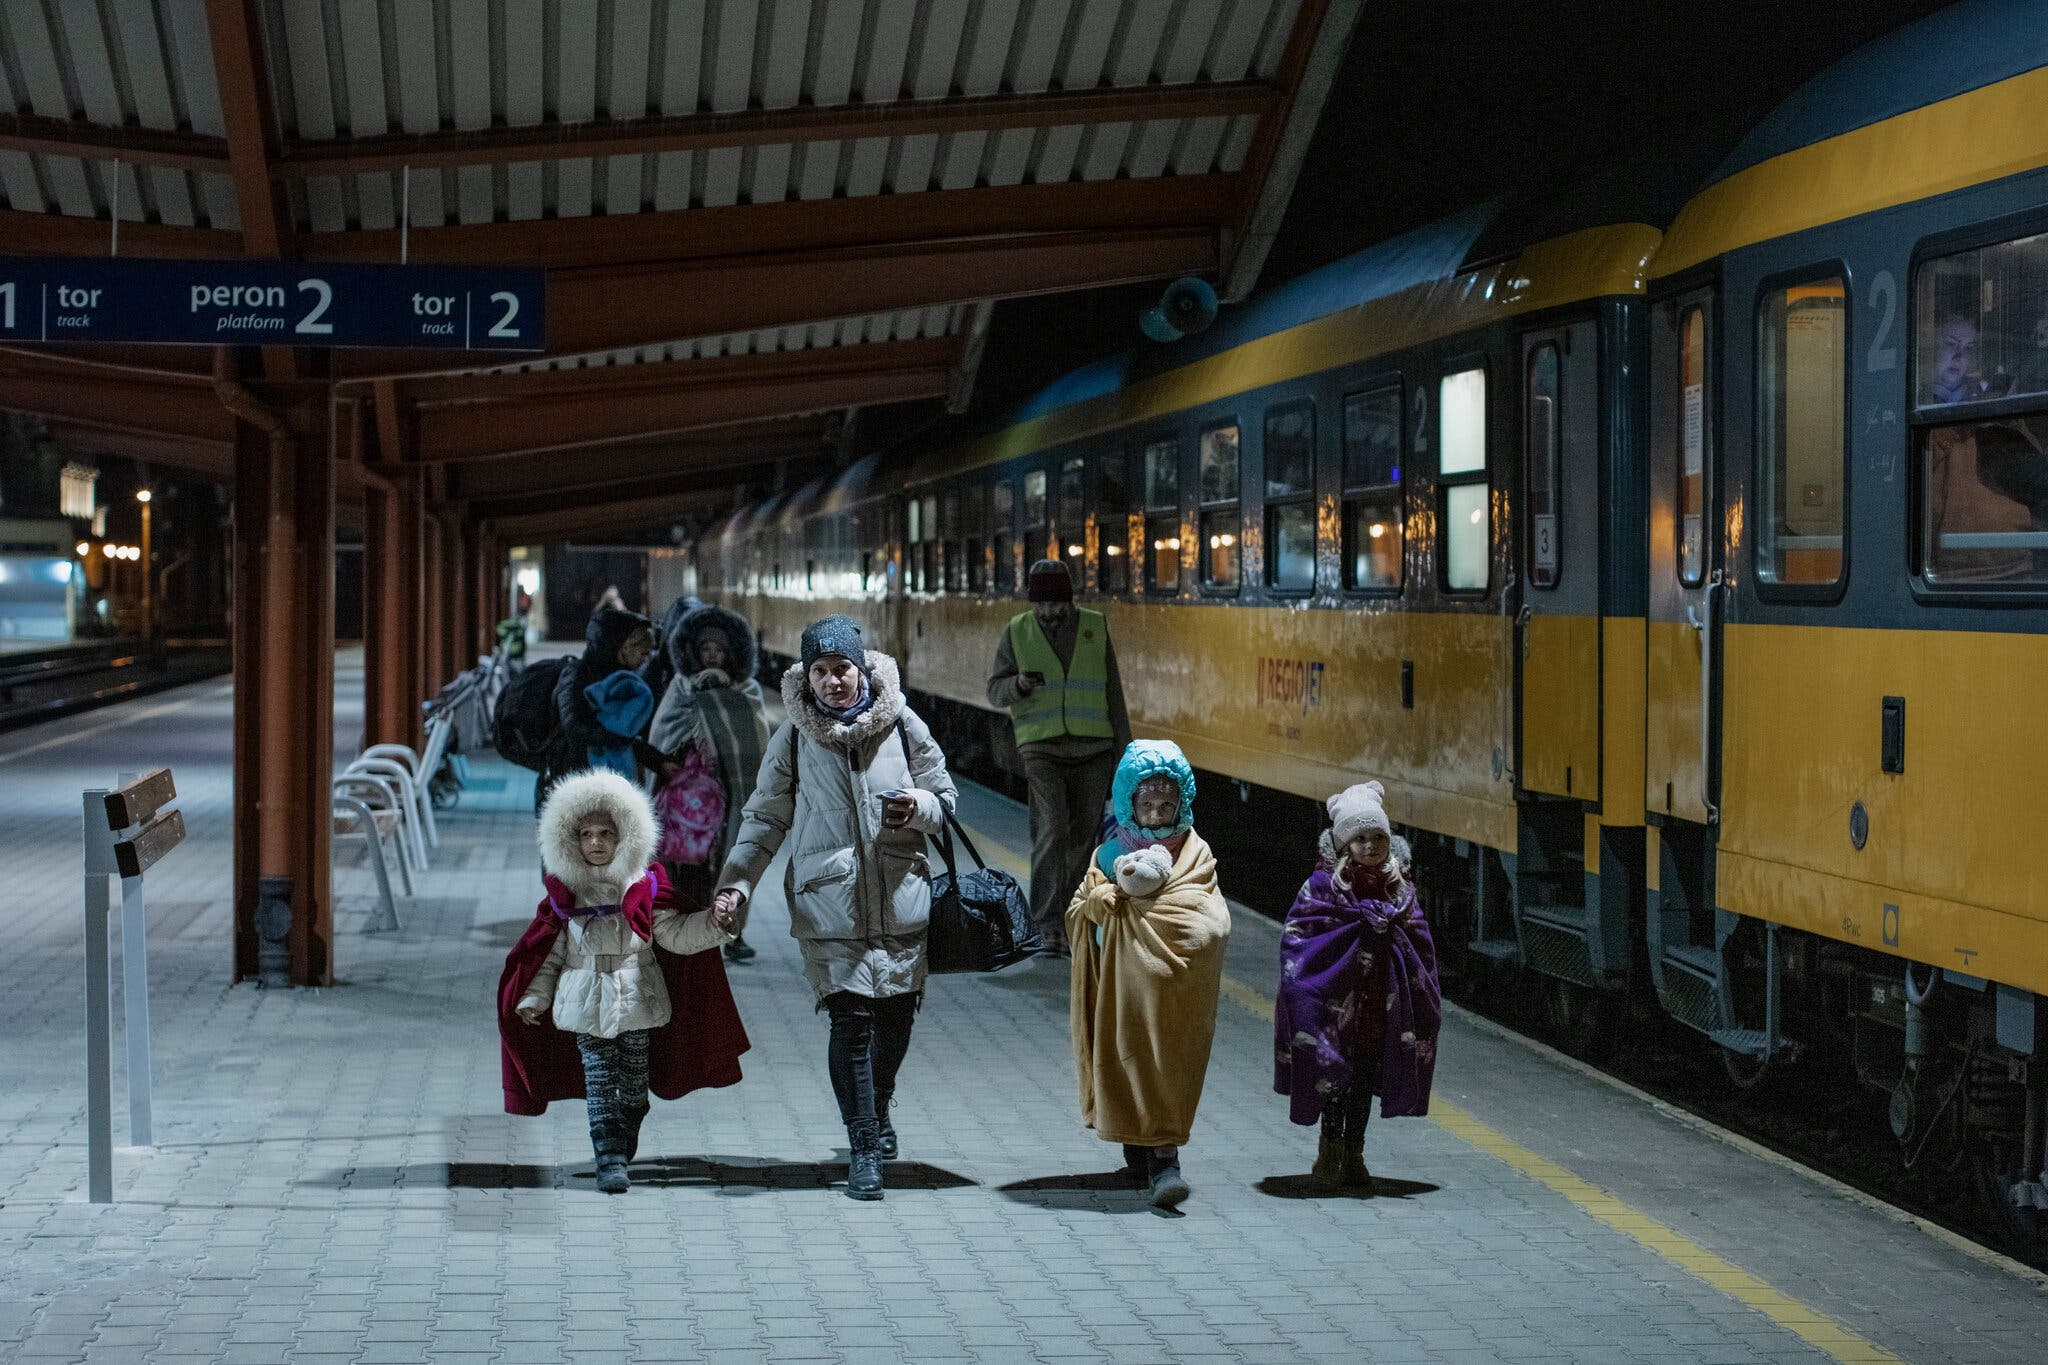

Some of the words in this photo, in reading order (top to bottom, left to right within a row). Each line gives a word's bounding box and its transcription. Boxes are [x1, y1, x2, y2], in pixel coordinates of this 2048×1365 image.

[0, 282, 16, 329] 1
[57, 285, 102, 308] tor
[190, 285, 286, 313] peron
[295, 278, 334, 334] 2
[411, 292, 456, 315] tor
[57, 315, 91, 328] track
[216, 313, 285, 332] platform
[421, 321, 455, 335] track
[488, 291, 520, 338] 2
[1867, 270, 1897, 372] 2
[1415, 385, 1428, 453] 2
